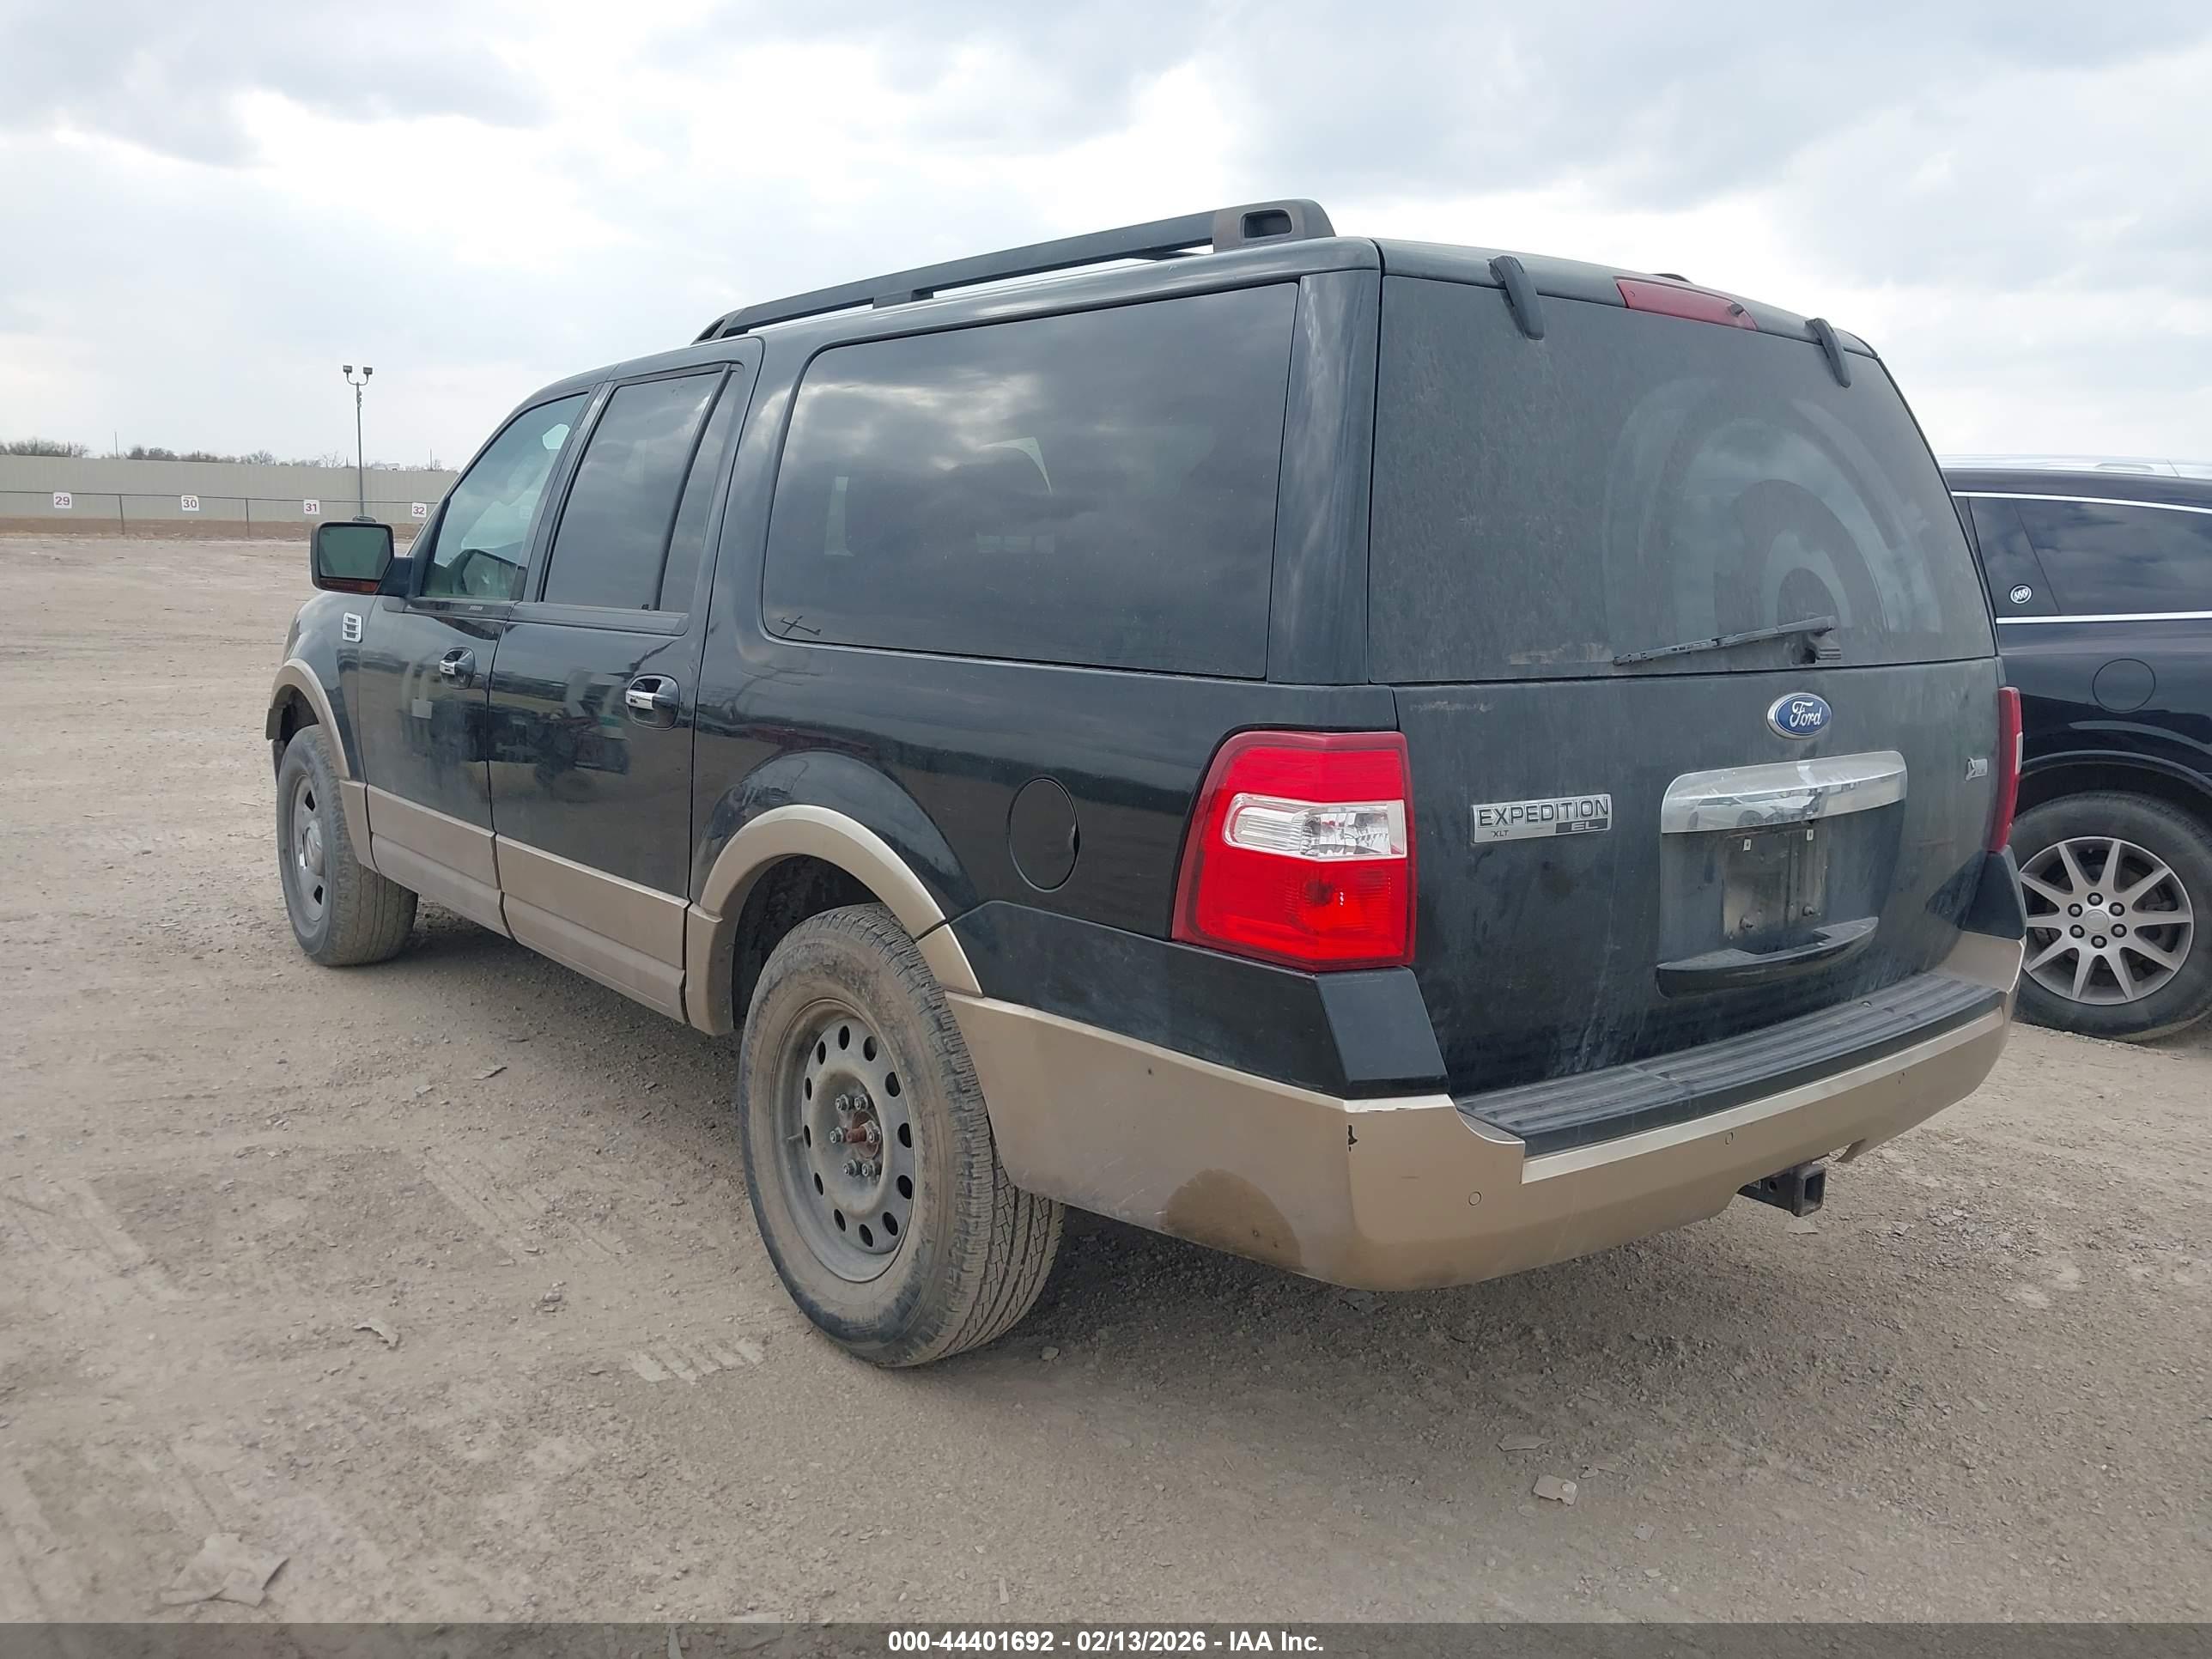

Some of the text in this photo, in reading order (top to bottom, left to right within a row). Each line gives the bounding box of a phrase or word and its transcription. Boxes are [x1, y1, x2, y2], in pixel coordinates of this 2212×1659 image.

[55, 495, 70, 506] 29
[182, 499, 198, 508] 30
[305, 502, 317, 512] 31
[412, 506, 425, 515] 32
[1789, 701, 1822, 727] Ford
[1478, 797, 1610, 827] EXPEDITION
[1571, 821, 1599, 831] EL
[1492, 830, 1509, 838] XLT
